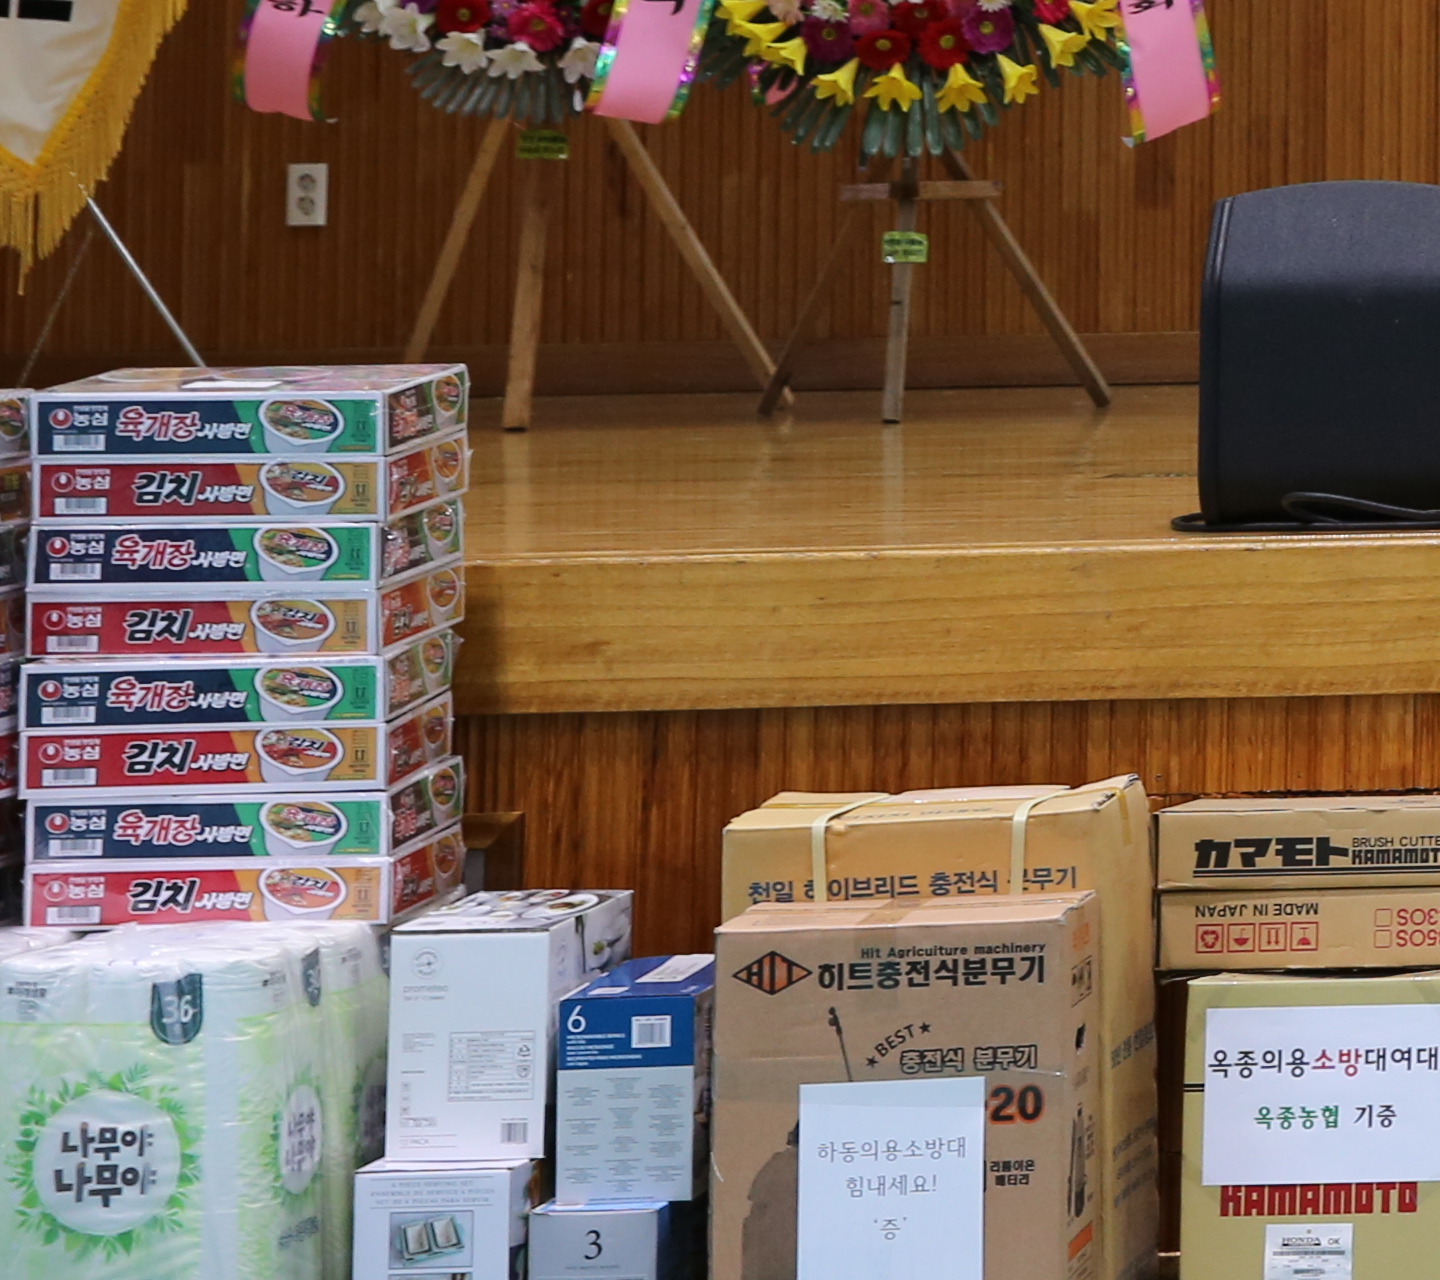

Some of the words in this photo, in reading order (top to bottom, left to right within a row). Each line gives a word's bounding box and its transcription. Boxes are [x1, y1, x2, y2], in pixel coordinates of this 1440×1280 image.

[73, 411, 108, 427] 농심
[116, 406, 201, 441] 육개장
[200, 422, 250, 439] 사발면
[74, 474, 111, 491] 농심
[133, 471, 201, 504] 김치
[199, 485, 254, 503] 사발면
[68, 539, 105, 555] 농심
[111, 534, 196, 570] 육개장
[193, 551, 248, 568] 사발면
[65, 612, 102, 629] 농심
[125, 608, 194, 642] 김치
[188, 623, 245, 640] 사발면
[62, 683, 99, 700] 농심
[107, 677, 195, 713] 육개장
[194, 692, 249, 709] 사발면
[63, 744, 100, 762] 농심
[123, 740, 196, 774] 김치
[191, 753, 249, 771] 사발면
[69, 814, 107, 832] 농심
[113, 809, 202, 845] 육개장
[200, 826, 254, 844] 사발면
[1192, 837, 1350, 869] カマモト
[1352, 836, 1394, 849] BRUSH
[68, 882, 105, 899] 농심
[128, 879, 199, 913] 김치
[195, 892, 254, 910] 사발면
[748, 881, 794, 904] 천일
[930, 870, 998, 894] 충전식
[1195, 904, 1252, 920] JAPAN
[1256, 903, 1270, 917] IN
[1274, 901, 1320, 916] MADE
[861, 946, 883, 959] Hit
[974, 941, 1047, 959] machinery
[819, 955, 1046, 993] 히트충전식분무기
[162, 994, 194, 1025] 36
[567, 1005, 587, 1033] 6
[875, 1023, 916, 1059] BEST
[900, 1049, 965, 1075] 충전식
[973, 1044, 1039, 1072] 분무기
[1208, 1045, 1440, 1080] 옥종의용소방대여대
[1253, 1104, 1340, 1131] 옥종농협
[1353, 1104, 1397, 1130] 기증
[816, 1136, 968, 1164] 하동의용소방대
[845, 1174, 938, 1198] 힘내세요!
[1219, 1182, 1418, 1217] KAMAMOTO
[584, 1229, 603, 1260] 3
[1281, 1235, 1322, 1248] HONDA
[1326, 1236, 1341, 1247] OK
